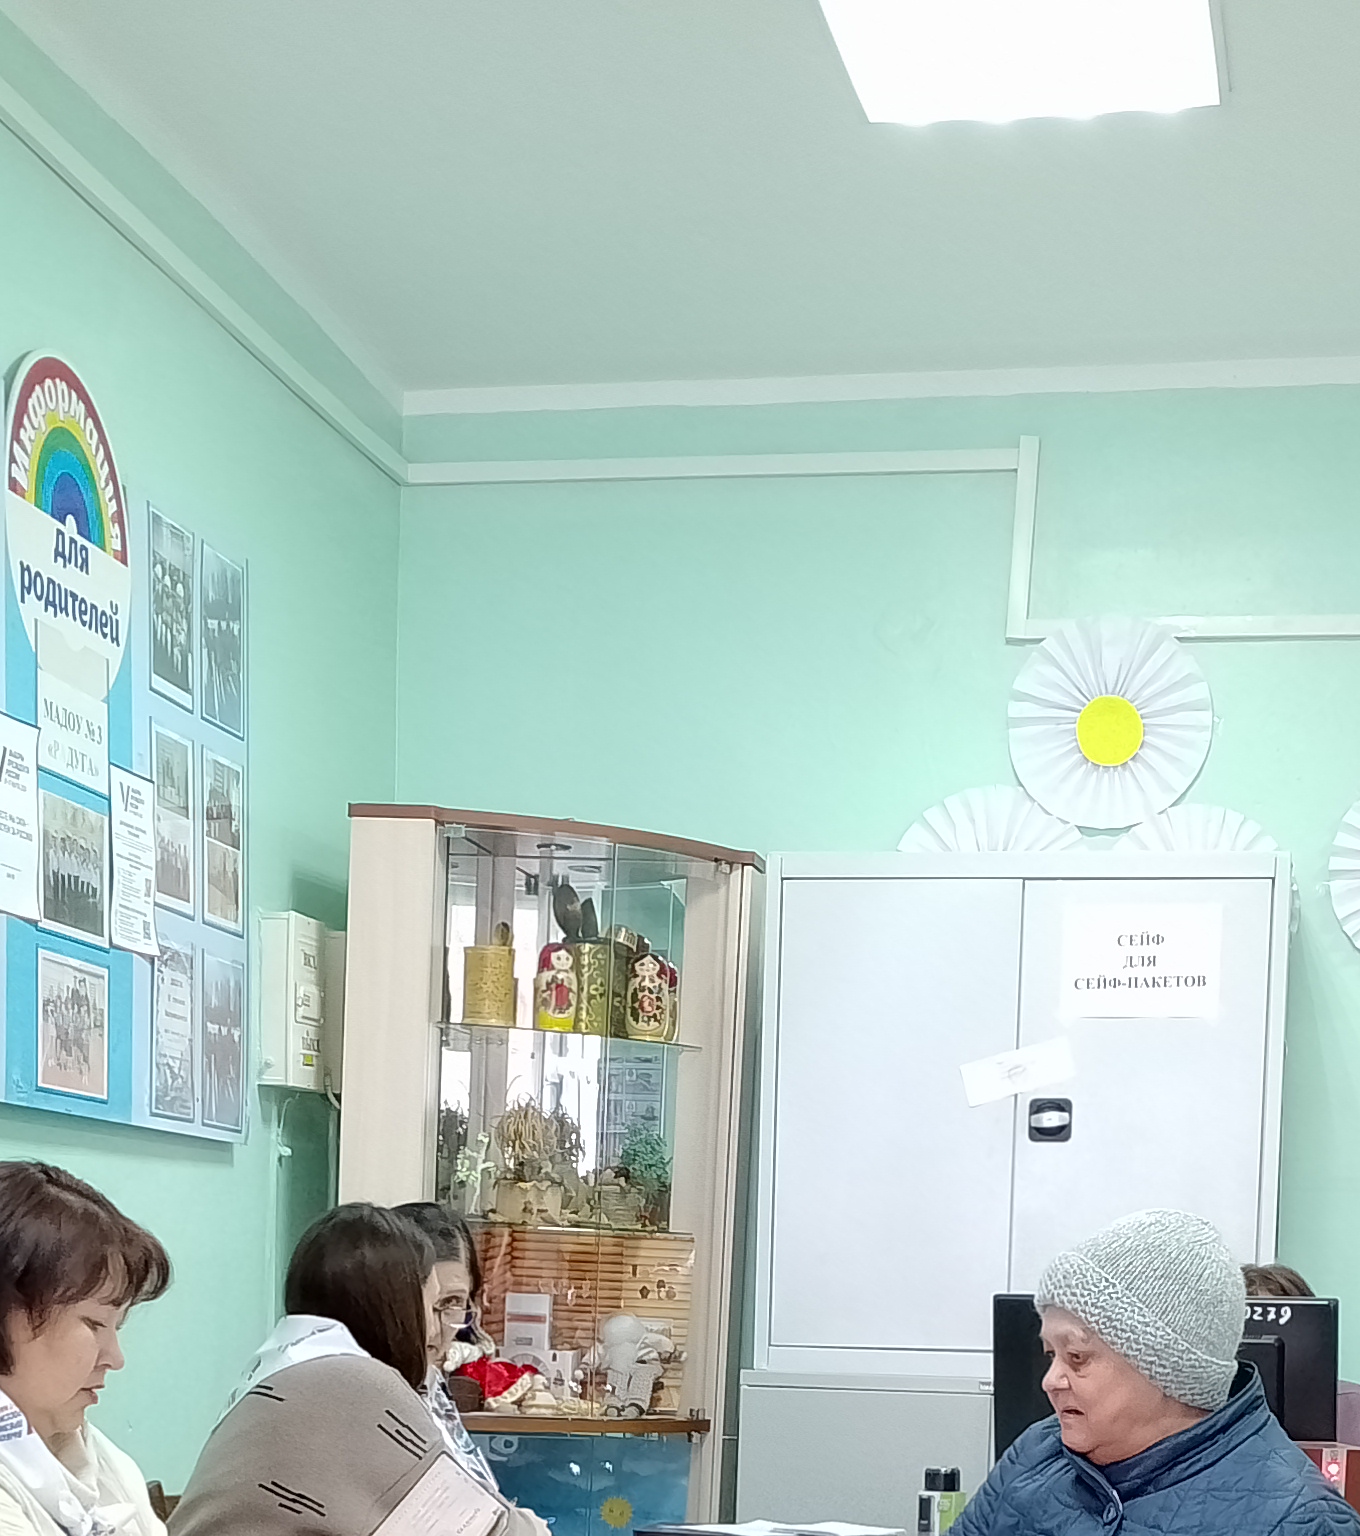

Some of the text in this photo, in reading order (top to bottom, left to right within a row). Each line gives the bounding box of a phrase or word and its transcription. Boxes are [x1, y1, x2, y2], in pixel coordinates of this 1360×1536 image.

[11, 378, 121, 551] Информация
[54, 528, 89, 575] для
[19, 560, 120, 647] родителей
[43, 698, 83, 735] МАДОУ
[47, 739, 100, 777] «РДУГА»
[1117, 931, 1165, 946] СЕЙФ
[1122, 955, 1157, 969] ДЛЯ
[1074, 974, 1207, 990] СЕЙФ-ПАКЕТОВ
